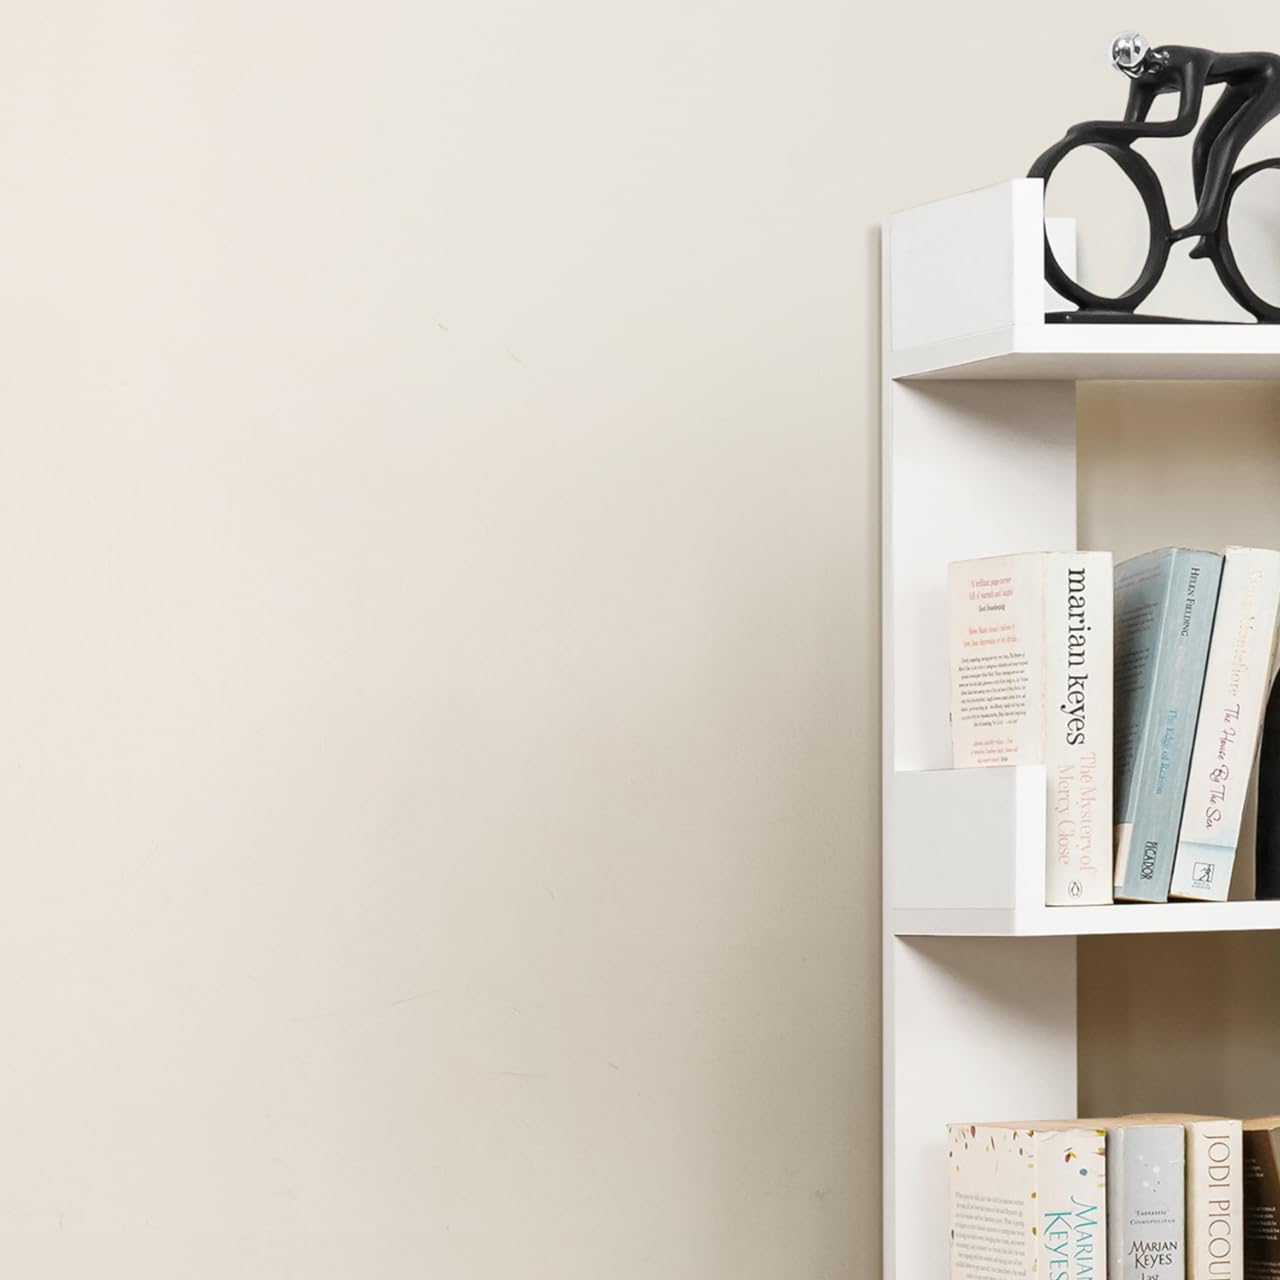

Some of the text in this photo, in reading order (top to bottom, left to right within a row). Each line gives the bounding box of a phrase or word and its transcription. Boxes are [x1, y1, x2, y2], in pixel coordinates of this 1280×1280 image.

[1181, 567, 1200, 637] HELEN FIELDING
[1060, 568, 1092, 746] marian keyes
[1205, 704, 1240, 830] The House By The Sea
[1055, 765, 1075, 865] Mercy Close
[1076, 752, 1098, 873] The Mystery of
[1141, 840, 1158, 880] PICADOR
[1202, 1134, 1231, 1188] JODI
[1128, 1240, 1178, 1255] MARIAN
[1135, 1253, 1173, 1269] KEYES
